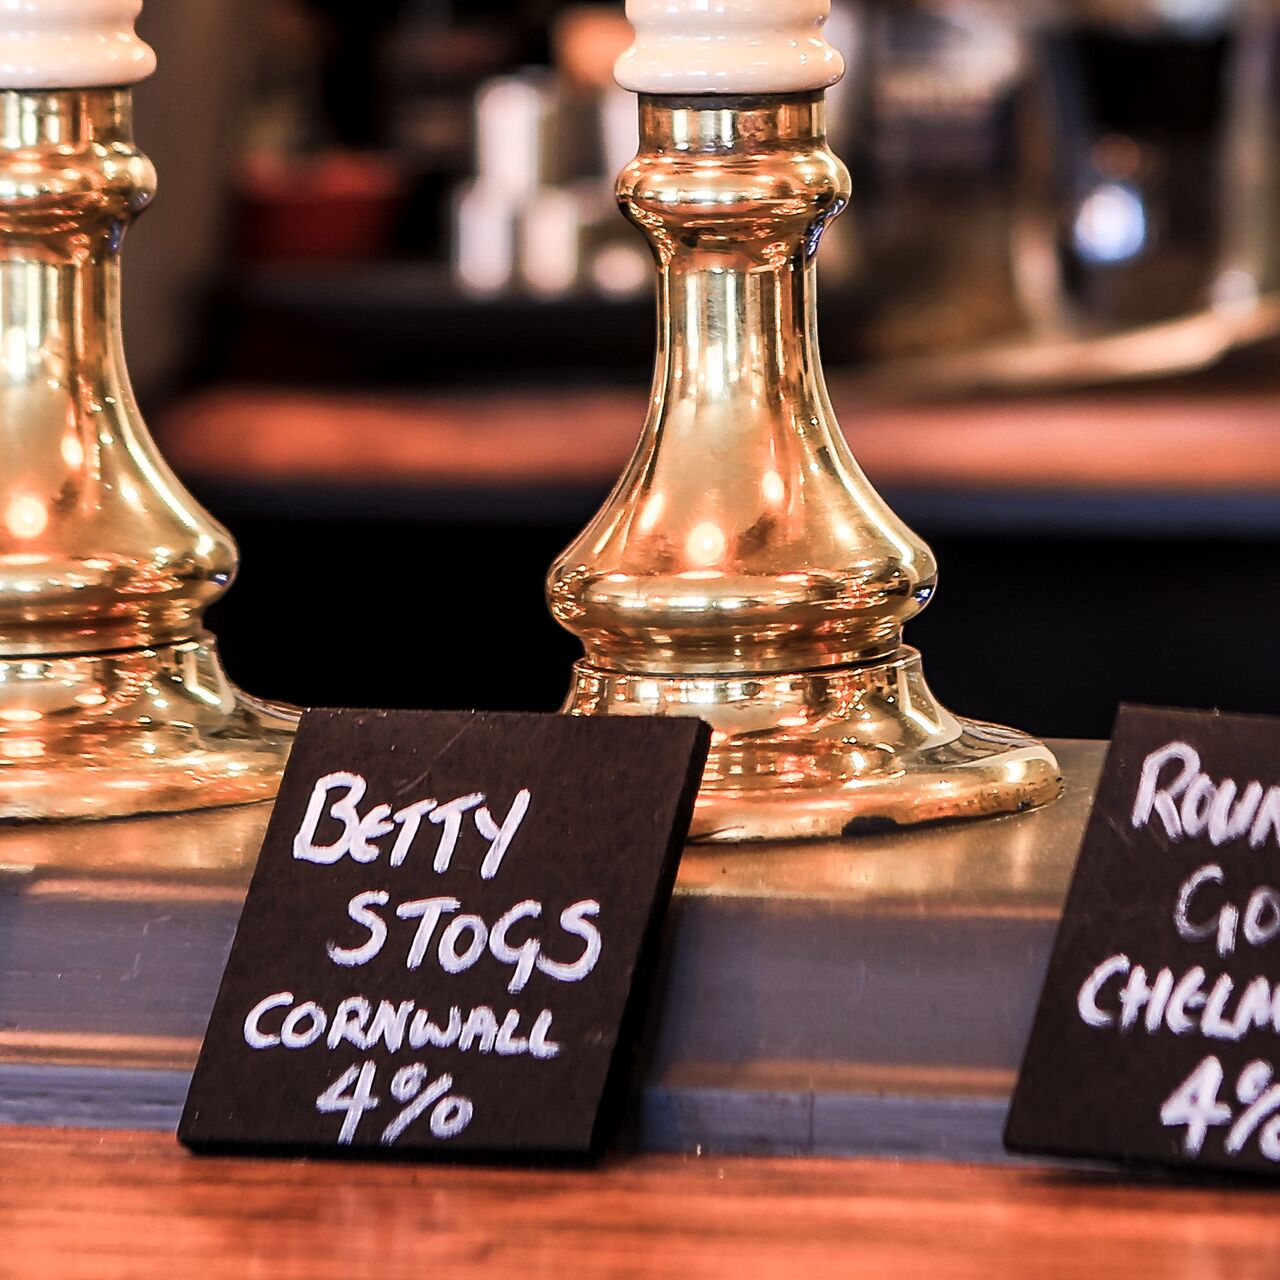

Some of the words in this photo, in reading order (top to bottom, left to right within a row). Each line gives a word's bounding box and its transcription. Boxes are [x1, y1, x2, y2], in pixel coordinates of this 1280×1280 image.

[293, 771, 531, 879] BETTY
[327, 891, 601, 994] STOGS
[244, 991, 561, 1059] CORNWALL
[316, 1060, 473, 1146] 4%
